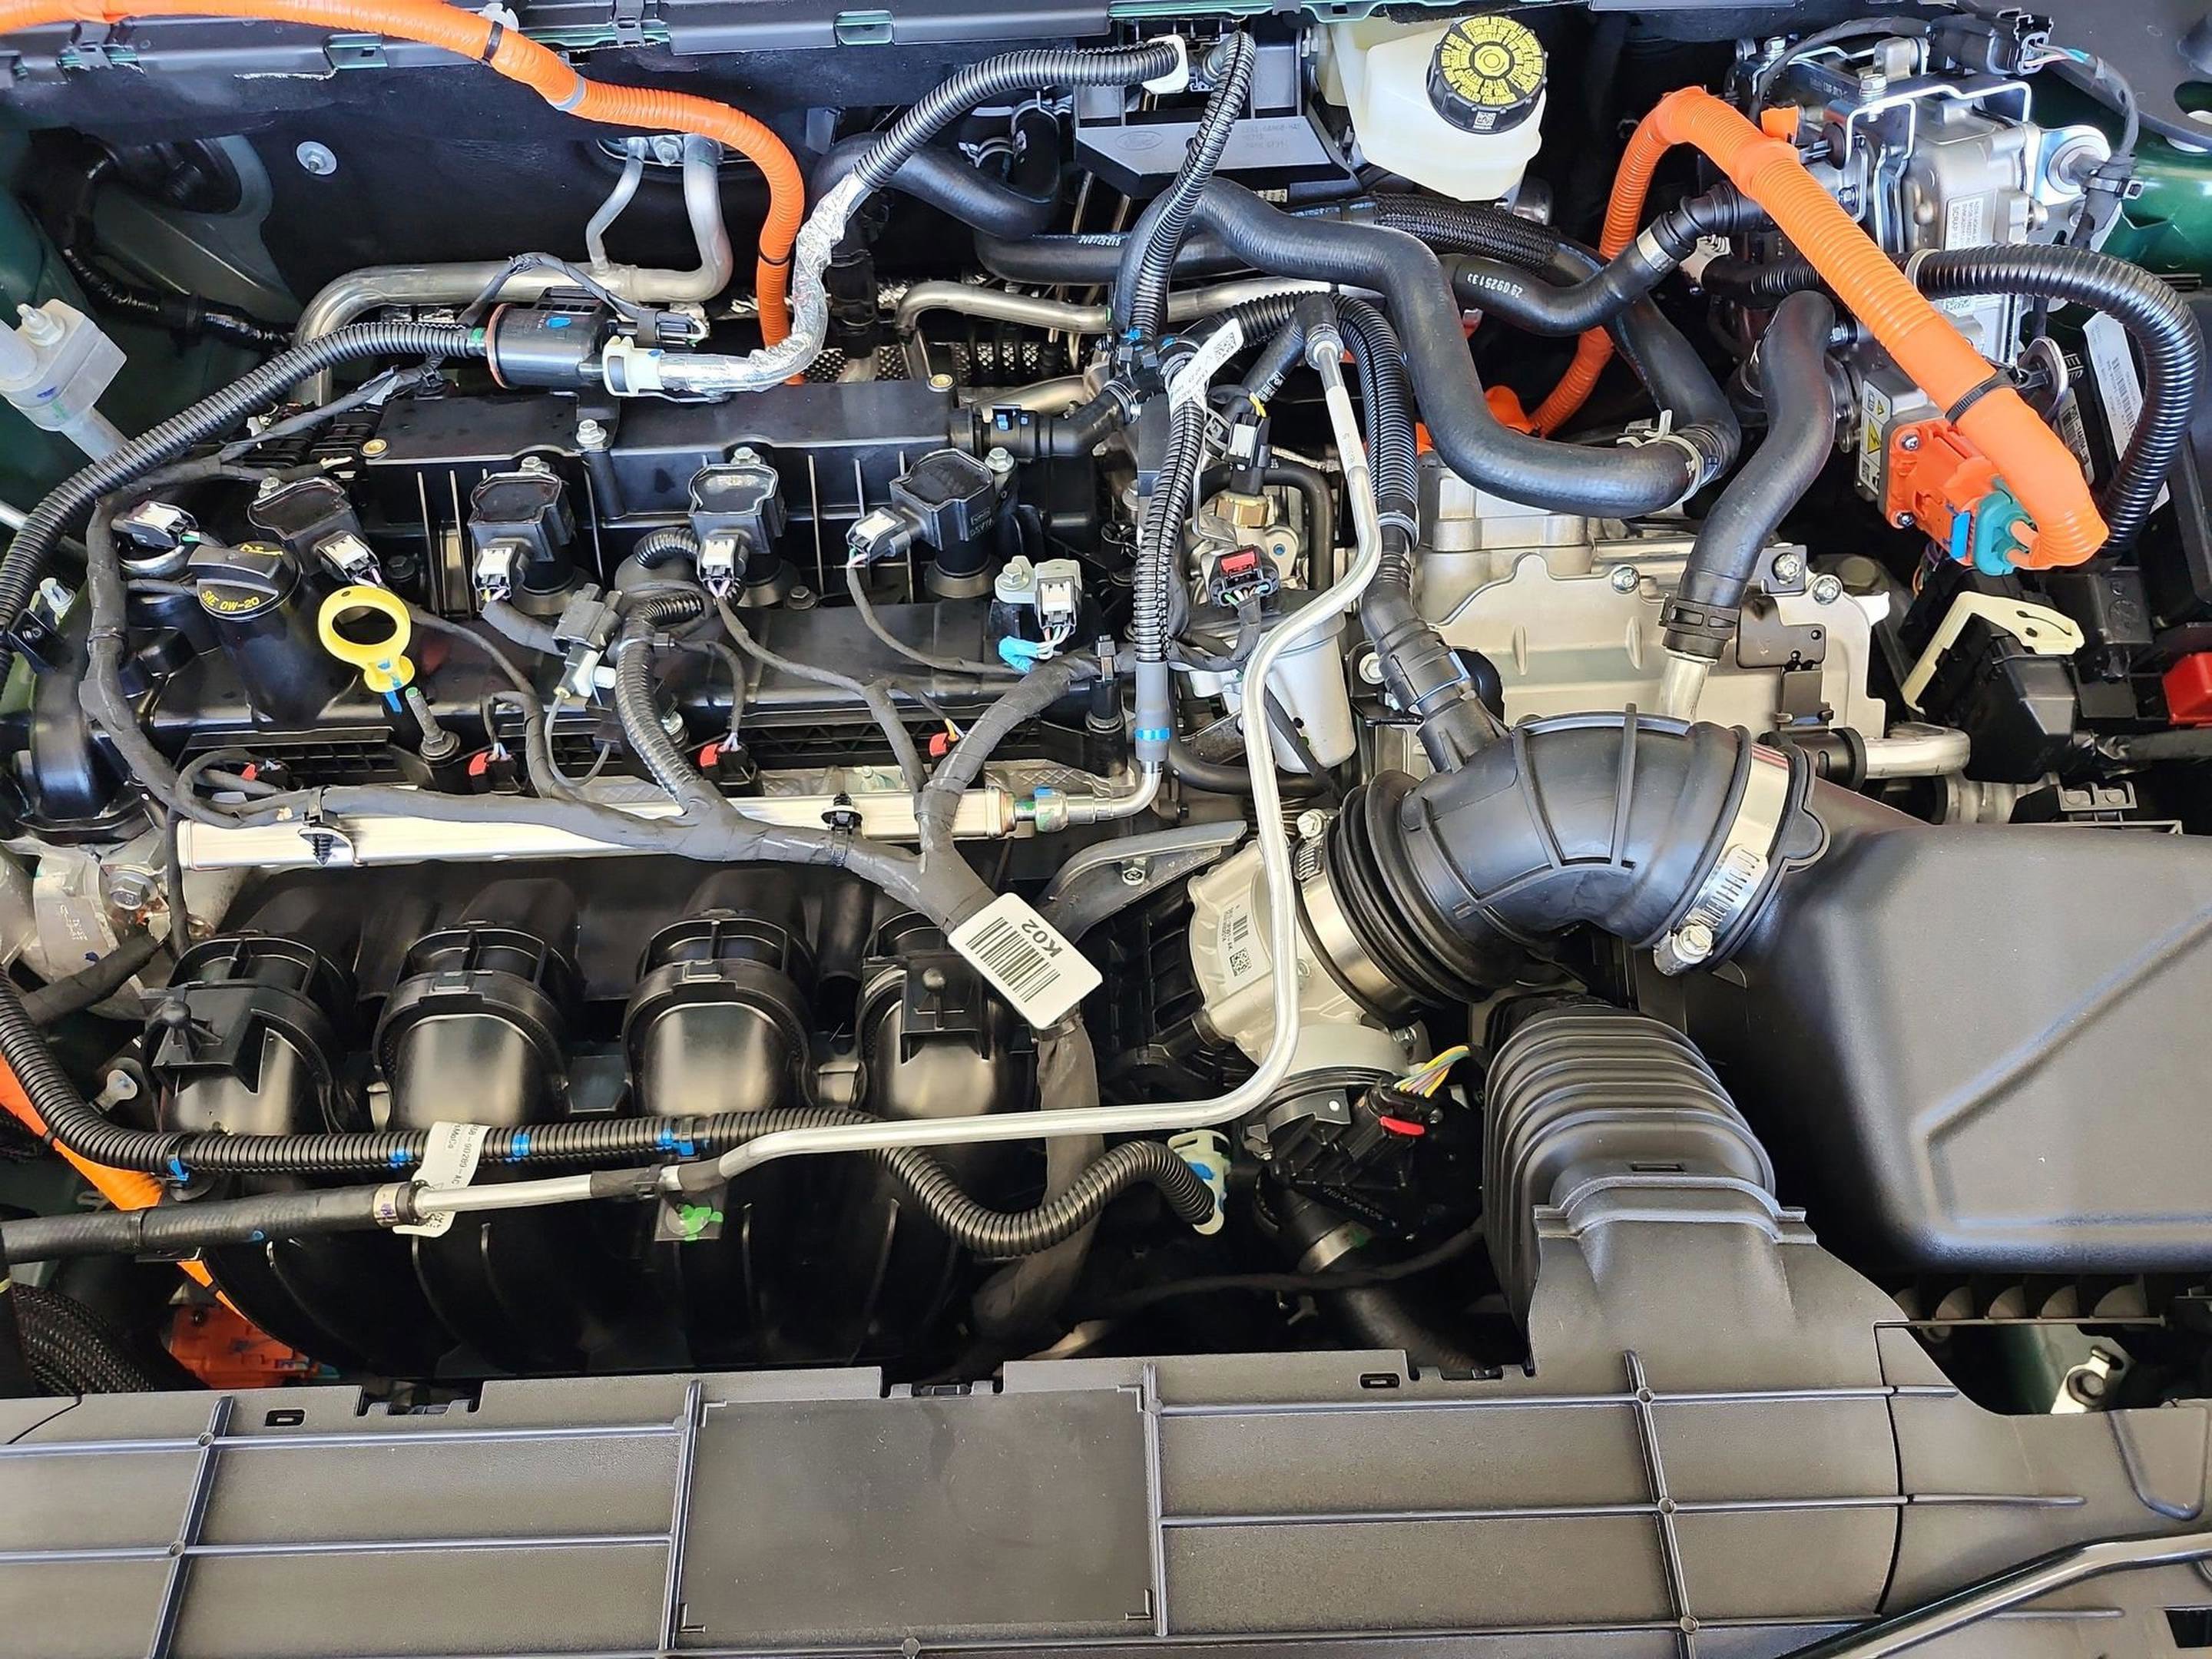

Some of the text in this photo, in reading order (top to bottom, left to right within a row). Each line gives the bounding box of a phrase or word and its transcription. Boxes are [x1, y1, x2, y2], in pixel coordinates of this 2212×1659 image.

[201, 590, 260, 611] SAE 0W-20
[1022, 919, 1064, 958] K02
